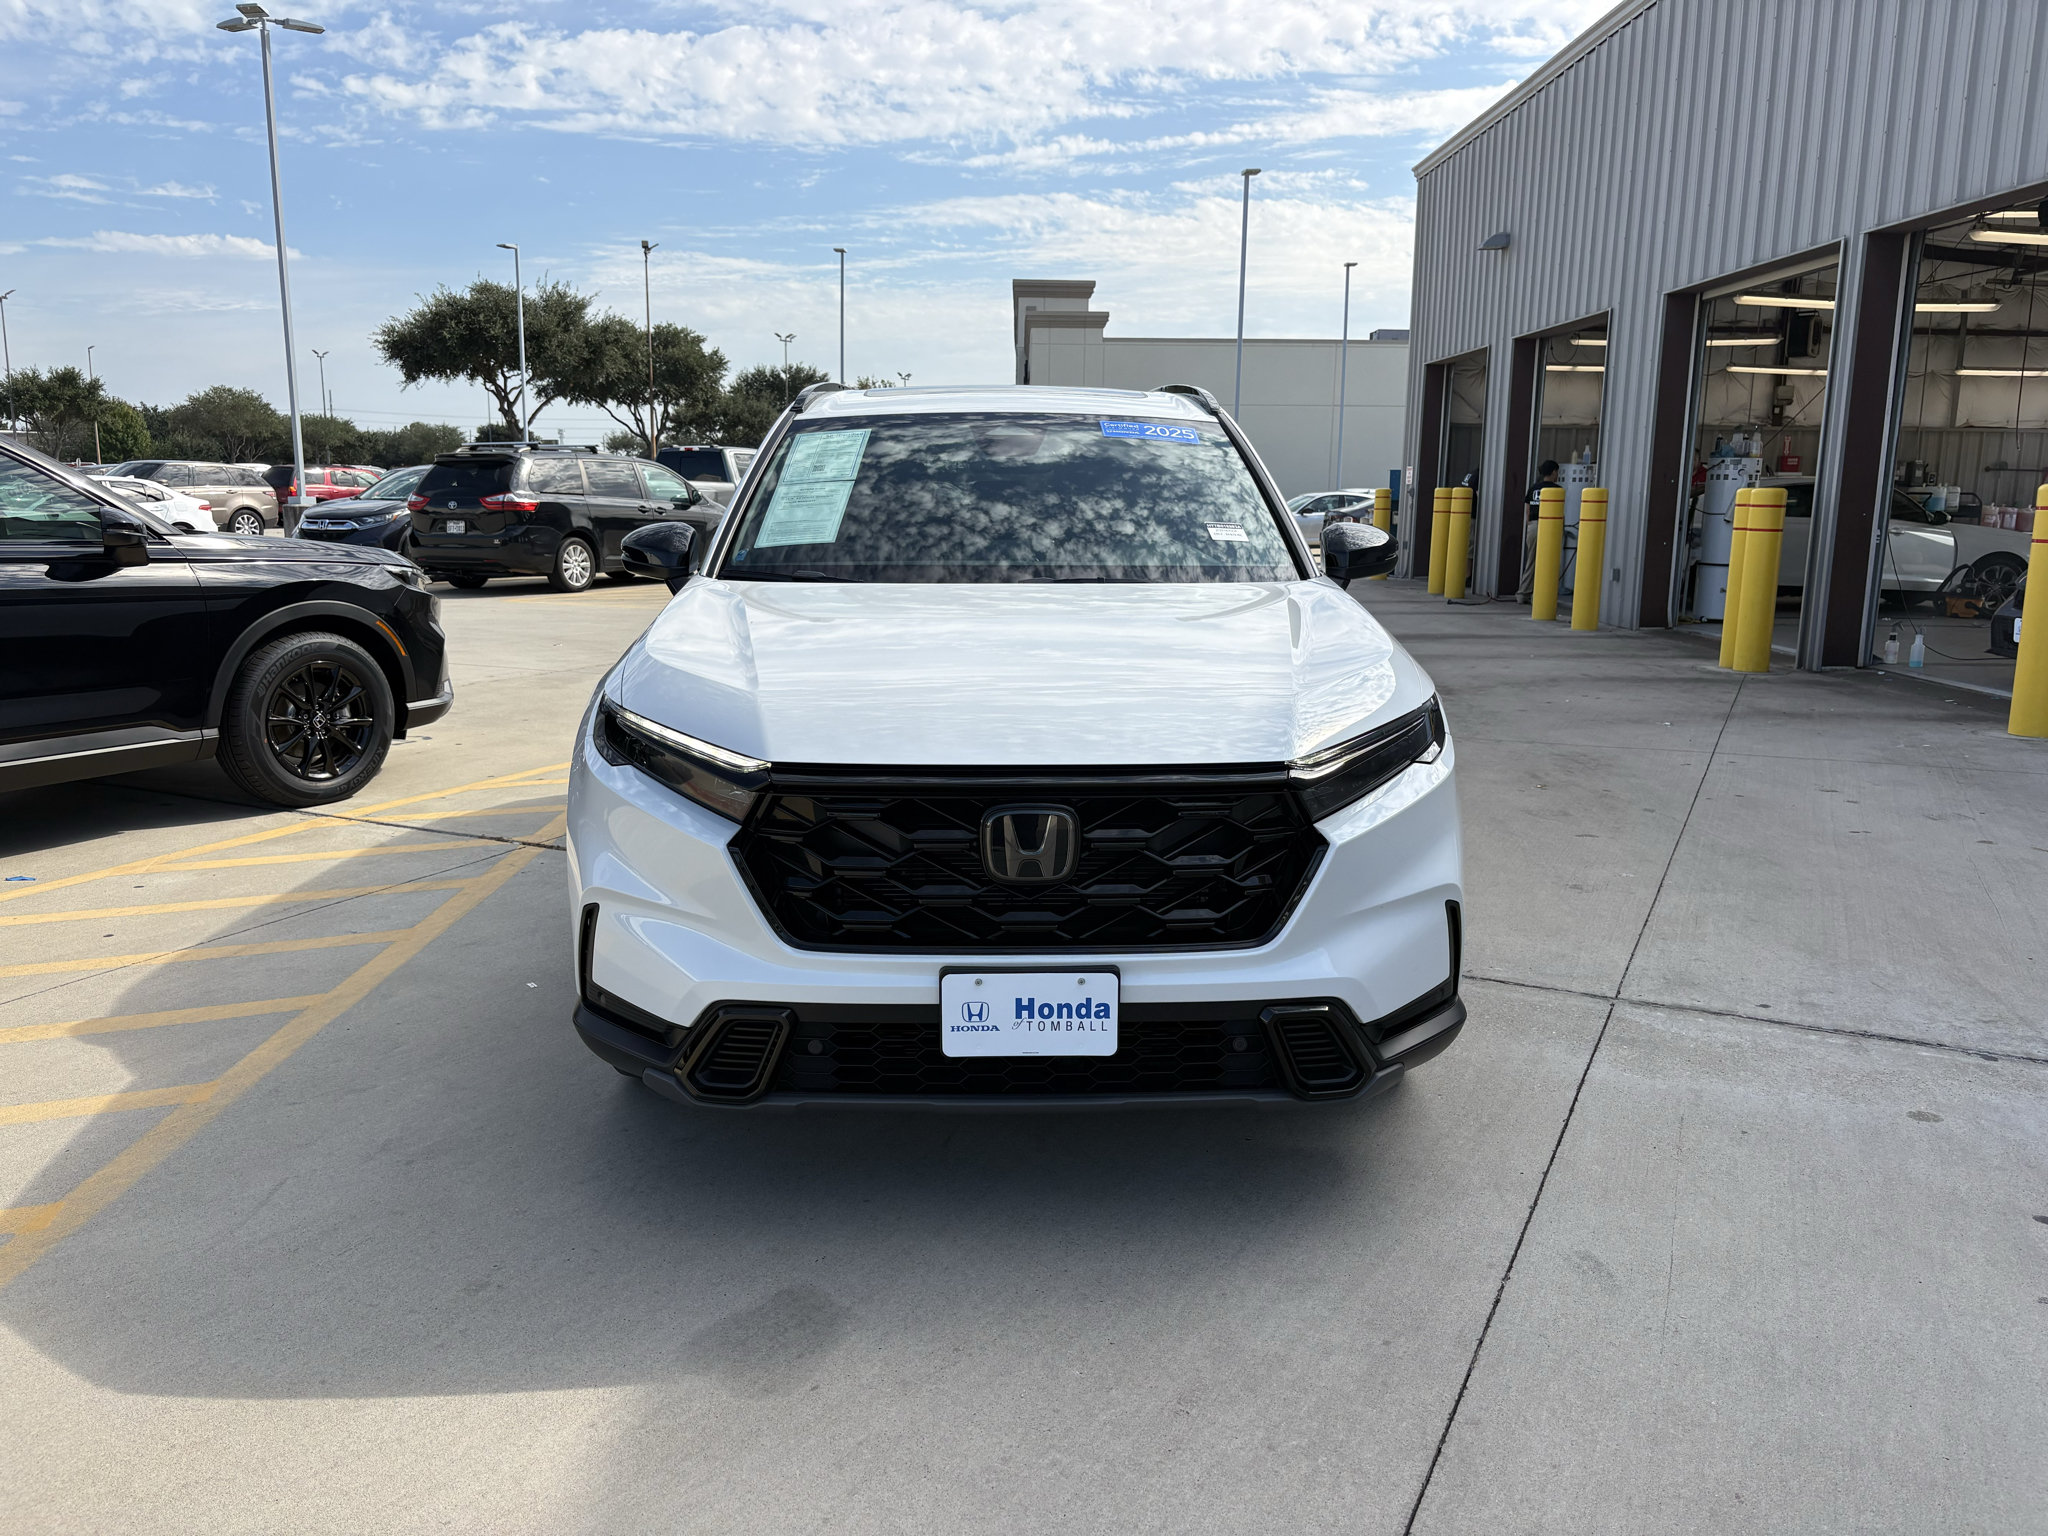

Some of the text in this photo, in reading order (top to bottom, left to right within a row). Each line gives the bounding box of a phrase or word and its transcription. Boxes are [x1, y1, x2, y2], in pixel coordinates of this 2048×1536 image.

[1143, 425, 1195, 440] 2025
[1015, 997, 1111, 1020] Honda
[1011, 1018, 1108, 1032] of TOMBALL
